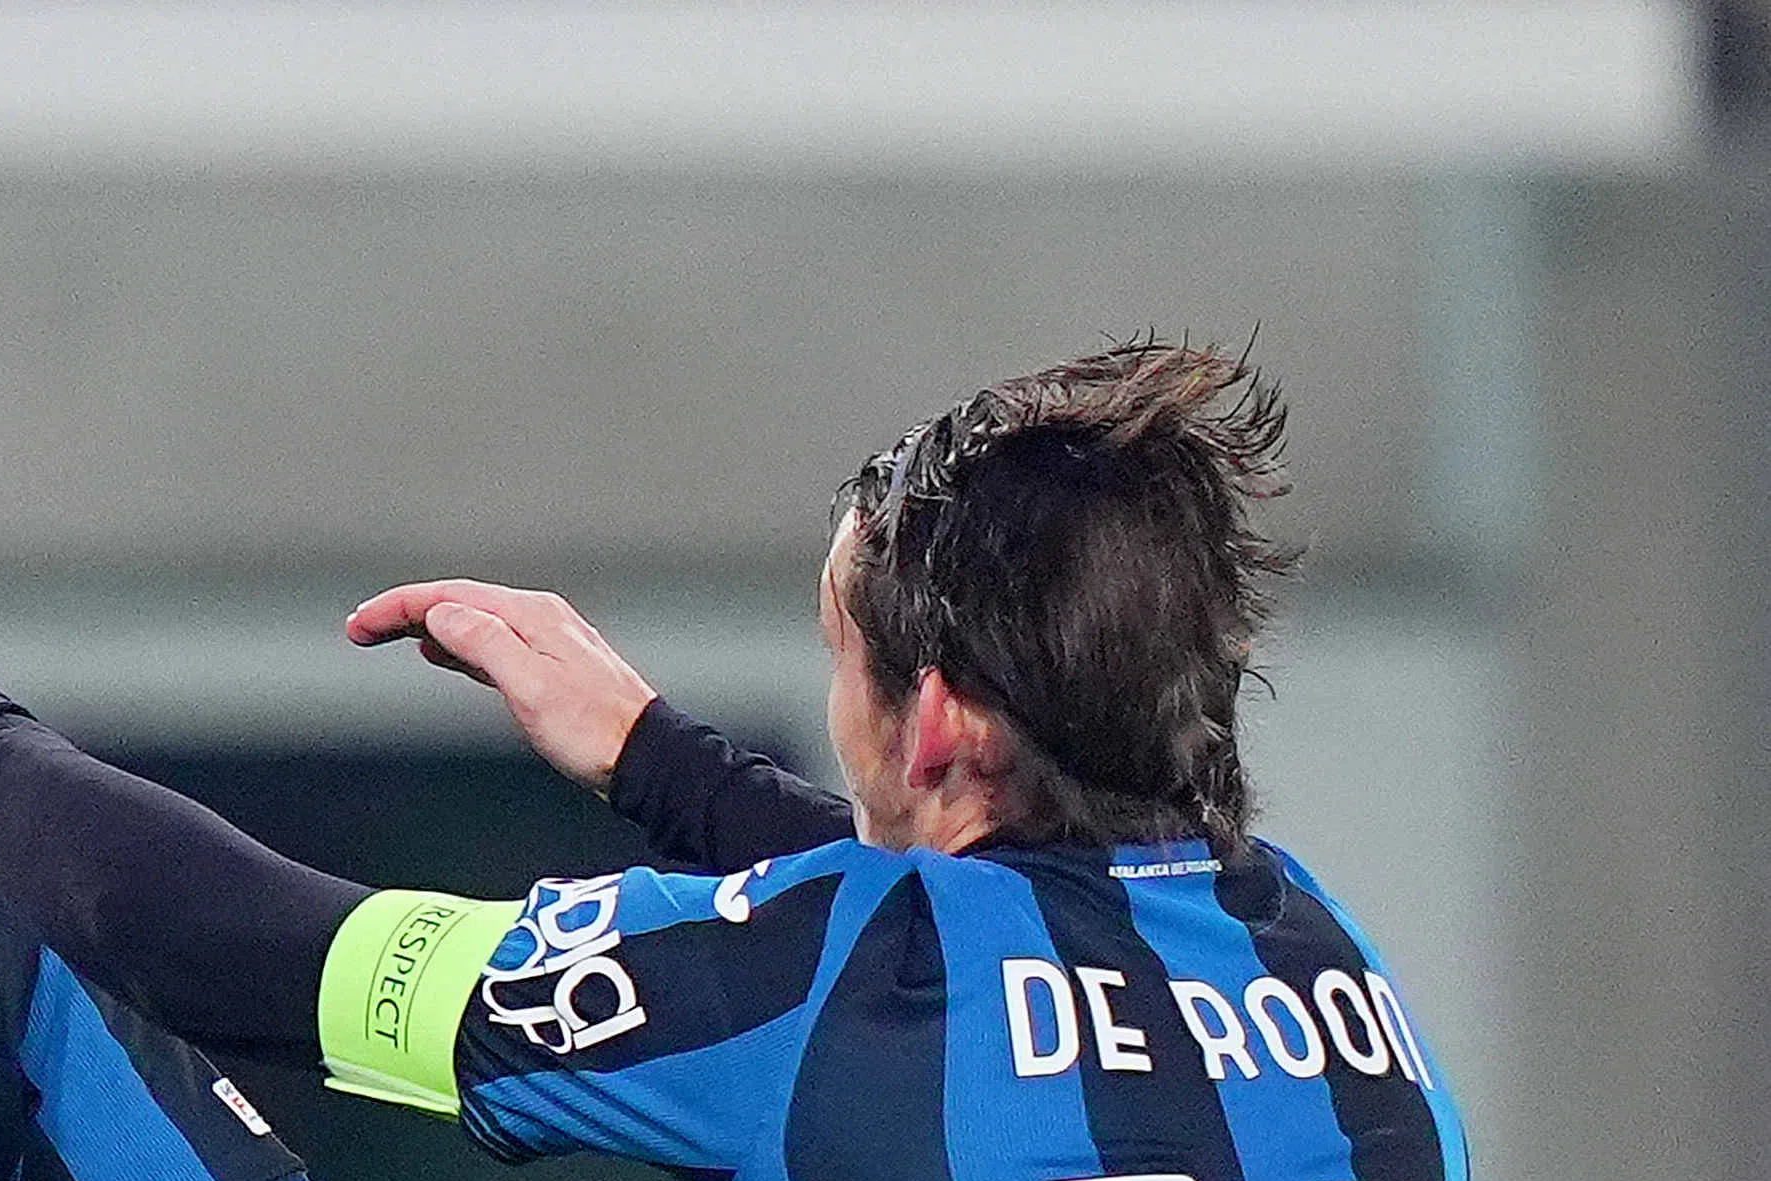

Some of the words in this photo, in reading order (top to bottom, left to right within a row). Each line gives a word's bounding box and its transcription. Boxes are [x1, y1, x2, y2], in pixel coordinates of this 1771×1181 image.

[375, 904, 457, 1050] RESPECT
[1001, 956, 1153, 1078] DE
[1168, 968, 1436, 1092] ROON
